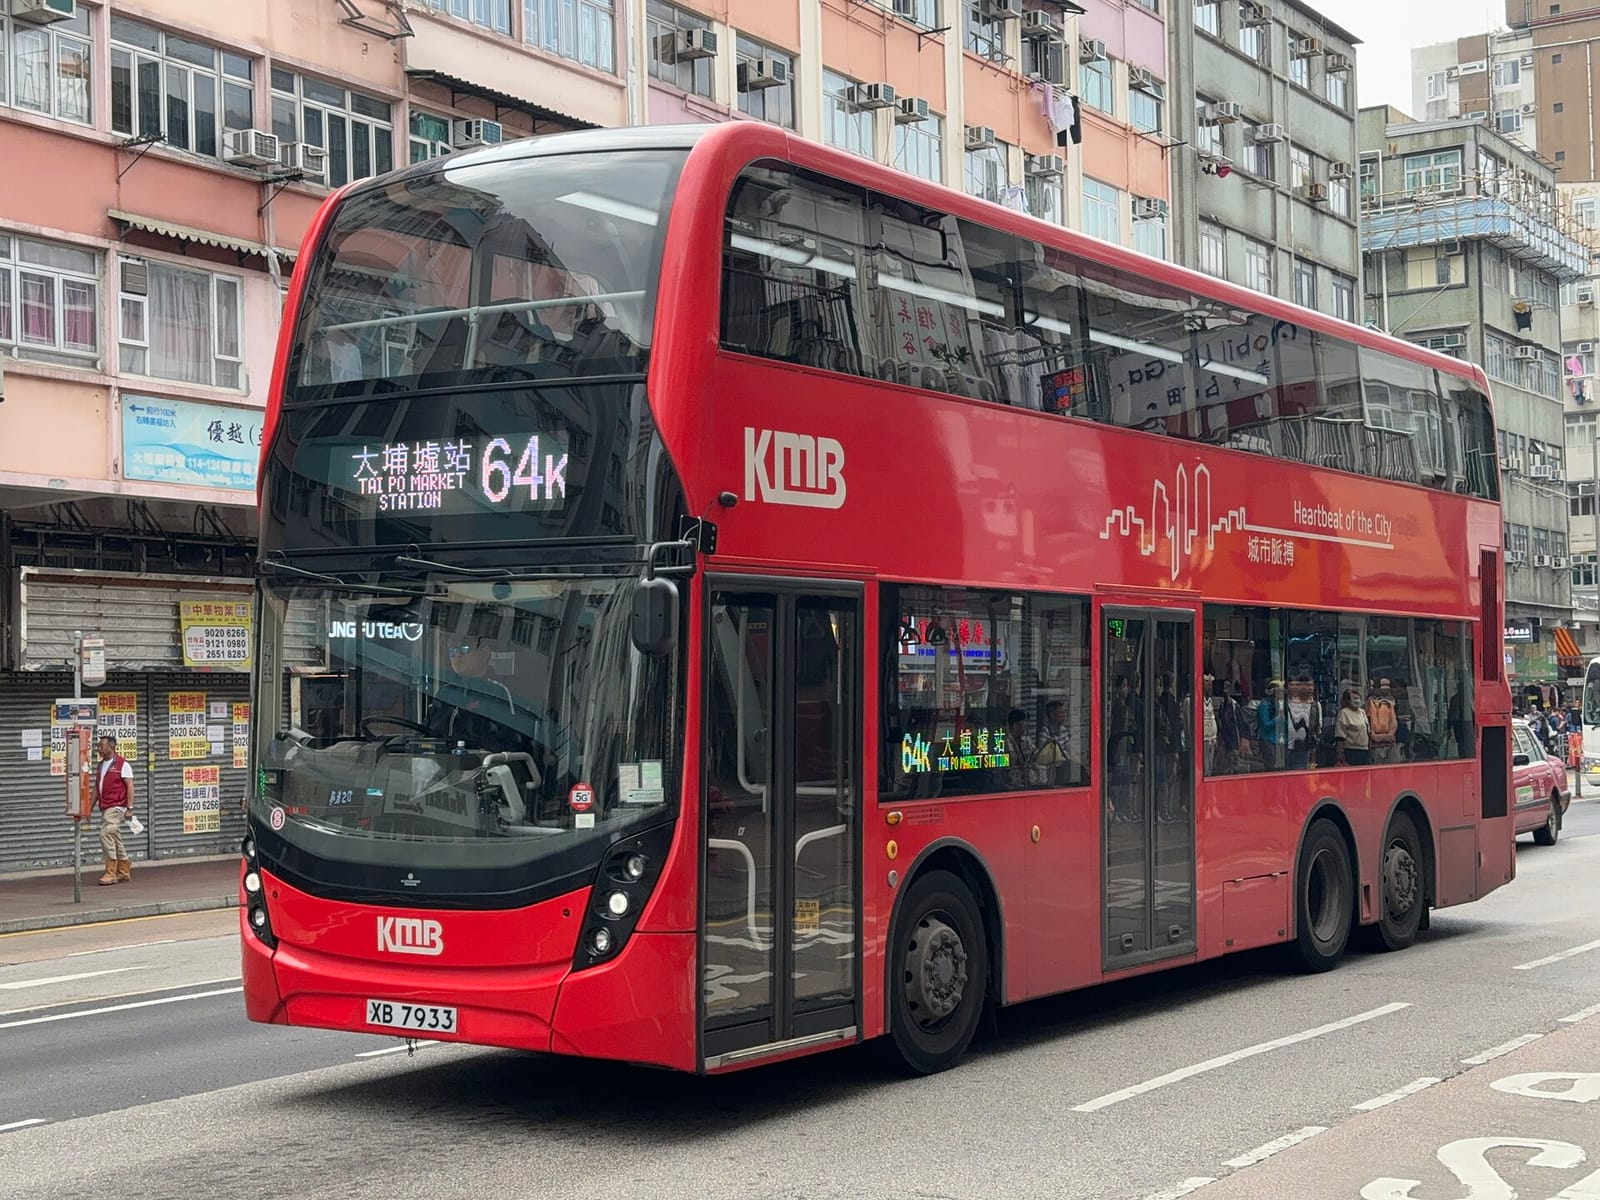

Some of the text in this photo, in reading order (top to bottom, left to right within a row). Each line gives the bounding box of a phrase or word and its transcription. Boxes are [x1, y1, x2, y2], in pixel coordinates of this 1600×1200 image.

[352, 438, 473, 478] 大埔墟站
[481, 435, 569, 503] 64K
[744, 426, 847, 510] KMB
[358, 472, 466, 495] TAI PO MARKET
[379, 491, 442, 511] STATION
[1294, 500, 1392, 543] Heartbeat of the City
[192, 604, 234, 617] 中華物業
[205, 629, 246, 638] 9020 6266
[376, 622, 403, 639] TEA
[205, 639, 225, 648] 9121
[227, 639, 246, 648] 0980
[206, 650, 225, 659] 2651
[227, 650, 246, 659] 8283
[99, 694, 135, 711] 中華物業
[170, 694, 205, 710] 中華物業
[118, 727, 137, 738] 6266
[169, 728, 187, 737] 9020
[902, 732, 932, 774] 64K
[937, 753, 1010, 771] TAI PO MARKET STATION
[185, 767, 218, 784] 中華物業
[183, 800, 219, 811] 9020 6266
[377, 916, 444, 956] KMB
[370, 1001, 453, 1030] XB 7933
